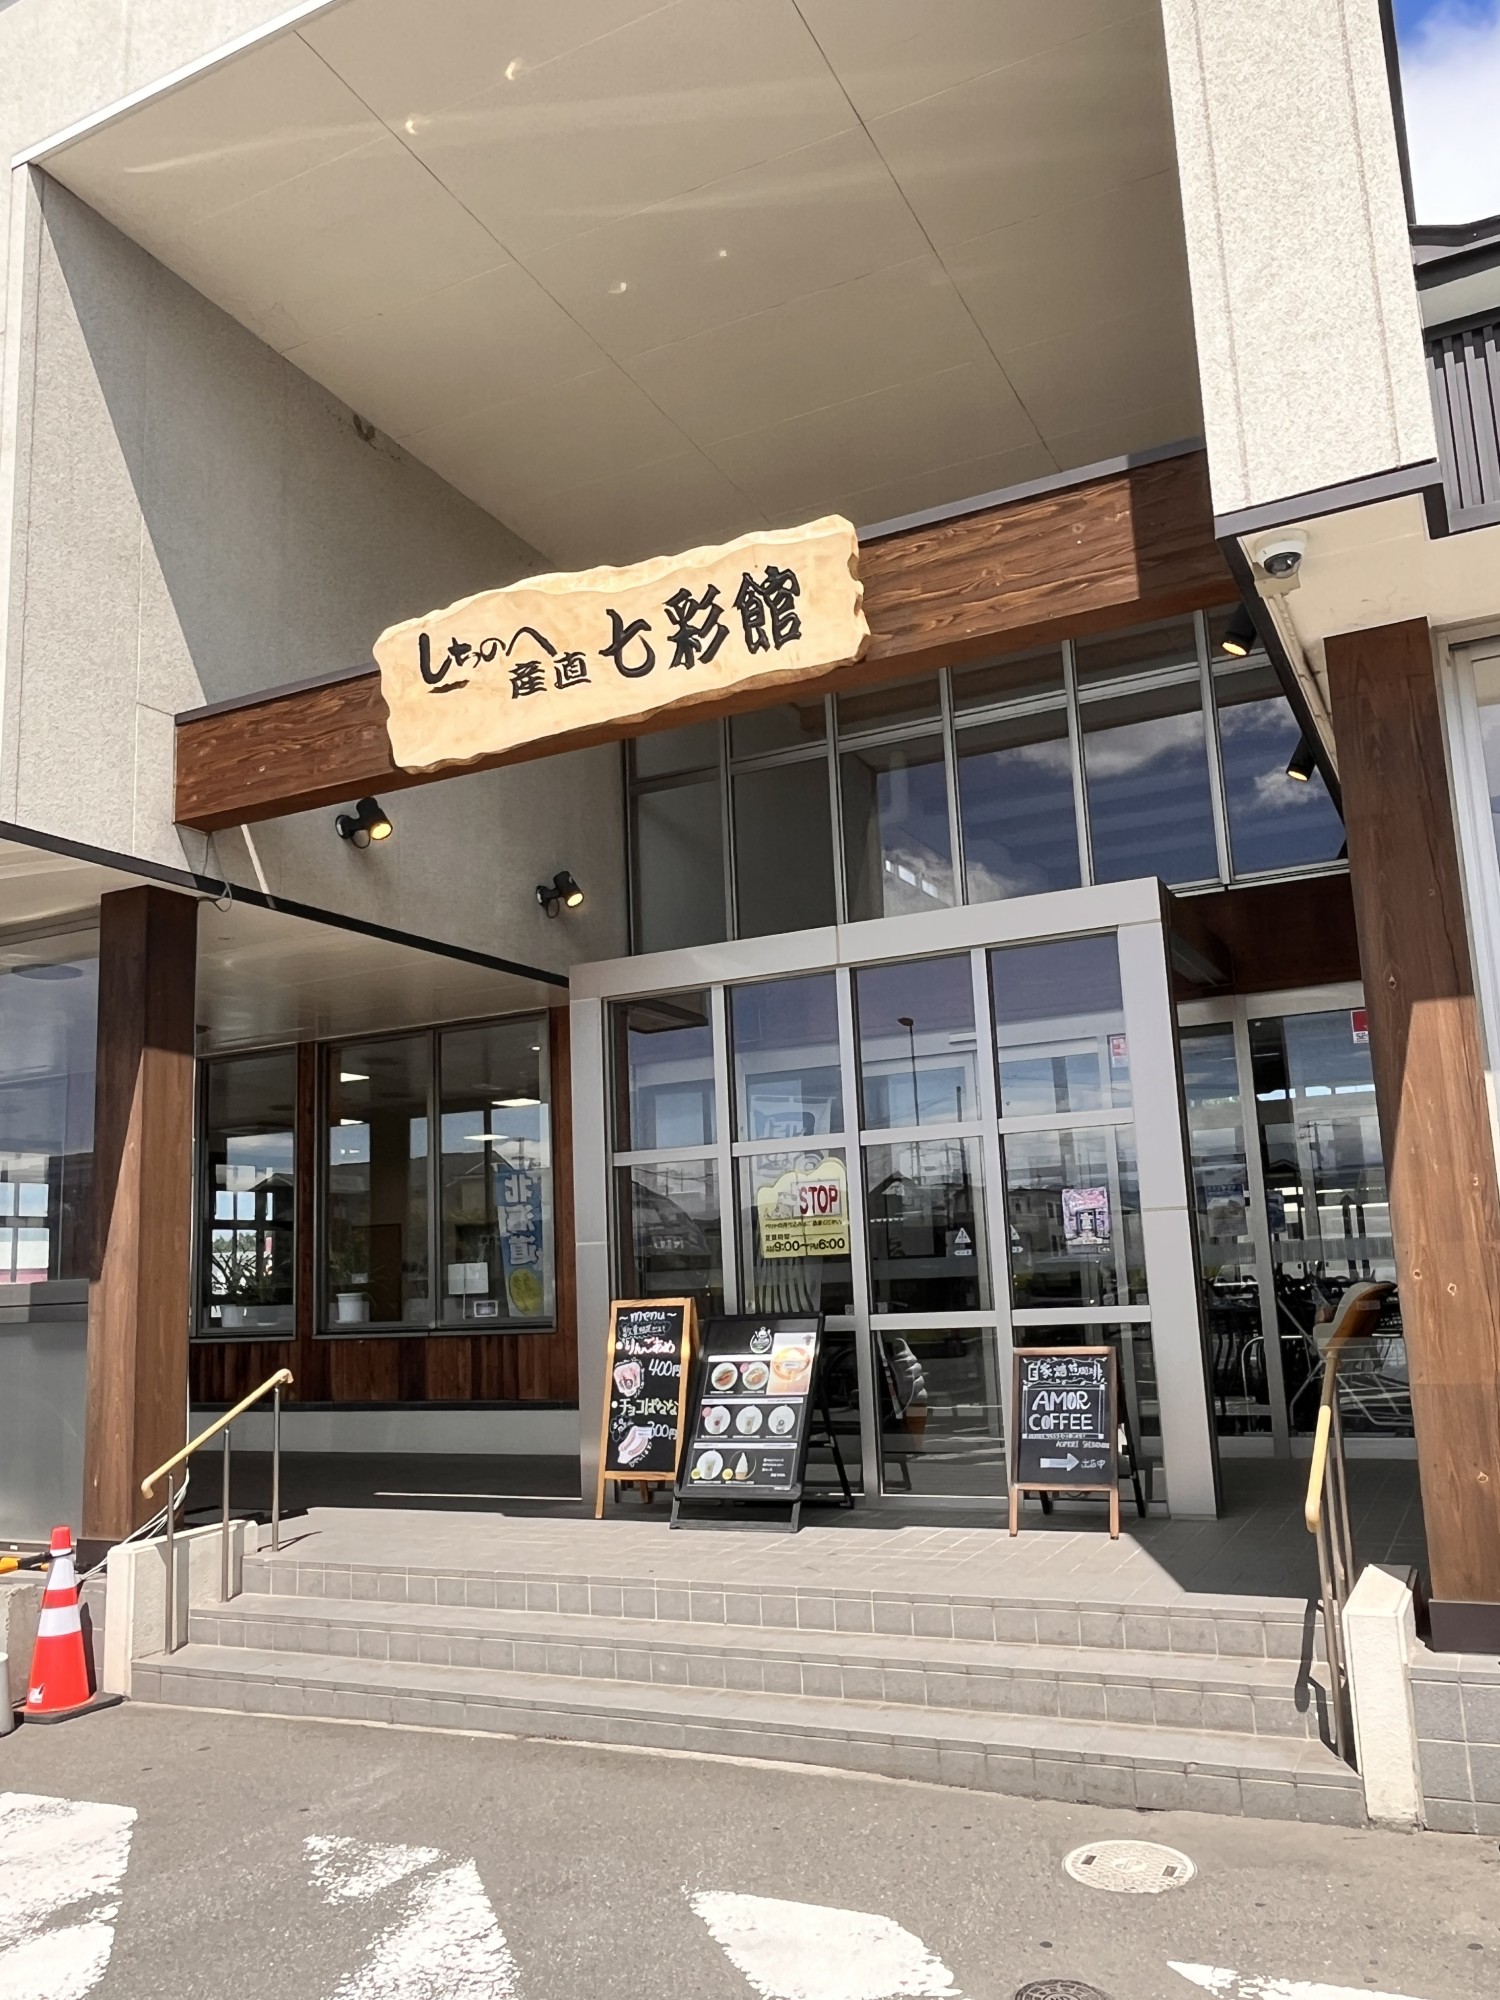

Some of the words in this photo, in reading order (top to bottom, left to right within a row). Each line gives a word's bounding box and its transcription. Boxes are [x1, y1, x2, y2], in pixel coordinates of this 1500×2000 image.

[597, 565, 802, 680] 七彩館
[508, 651, 593, 700] 産直
[798, 1184, 838, 1215] STOP
[1032, 1391, 1091, 1411] AMOR
[1028, 1413, 1093, 1431] COFFEE
